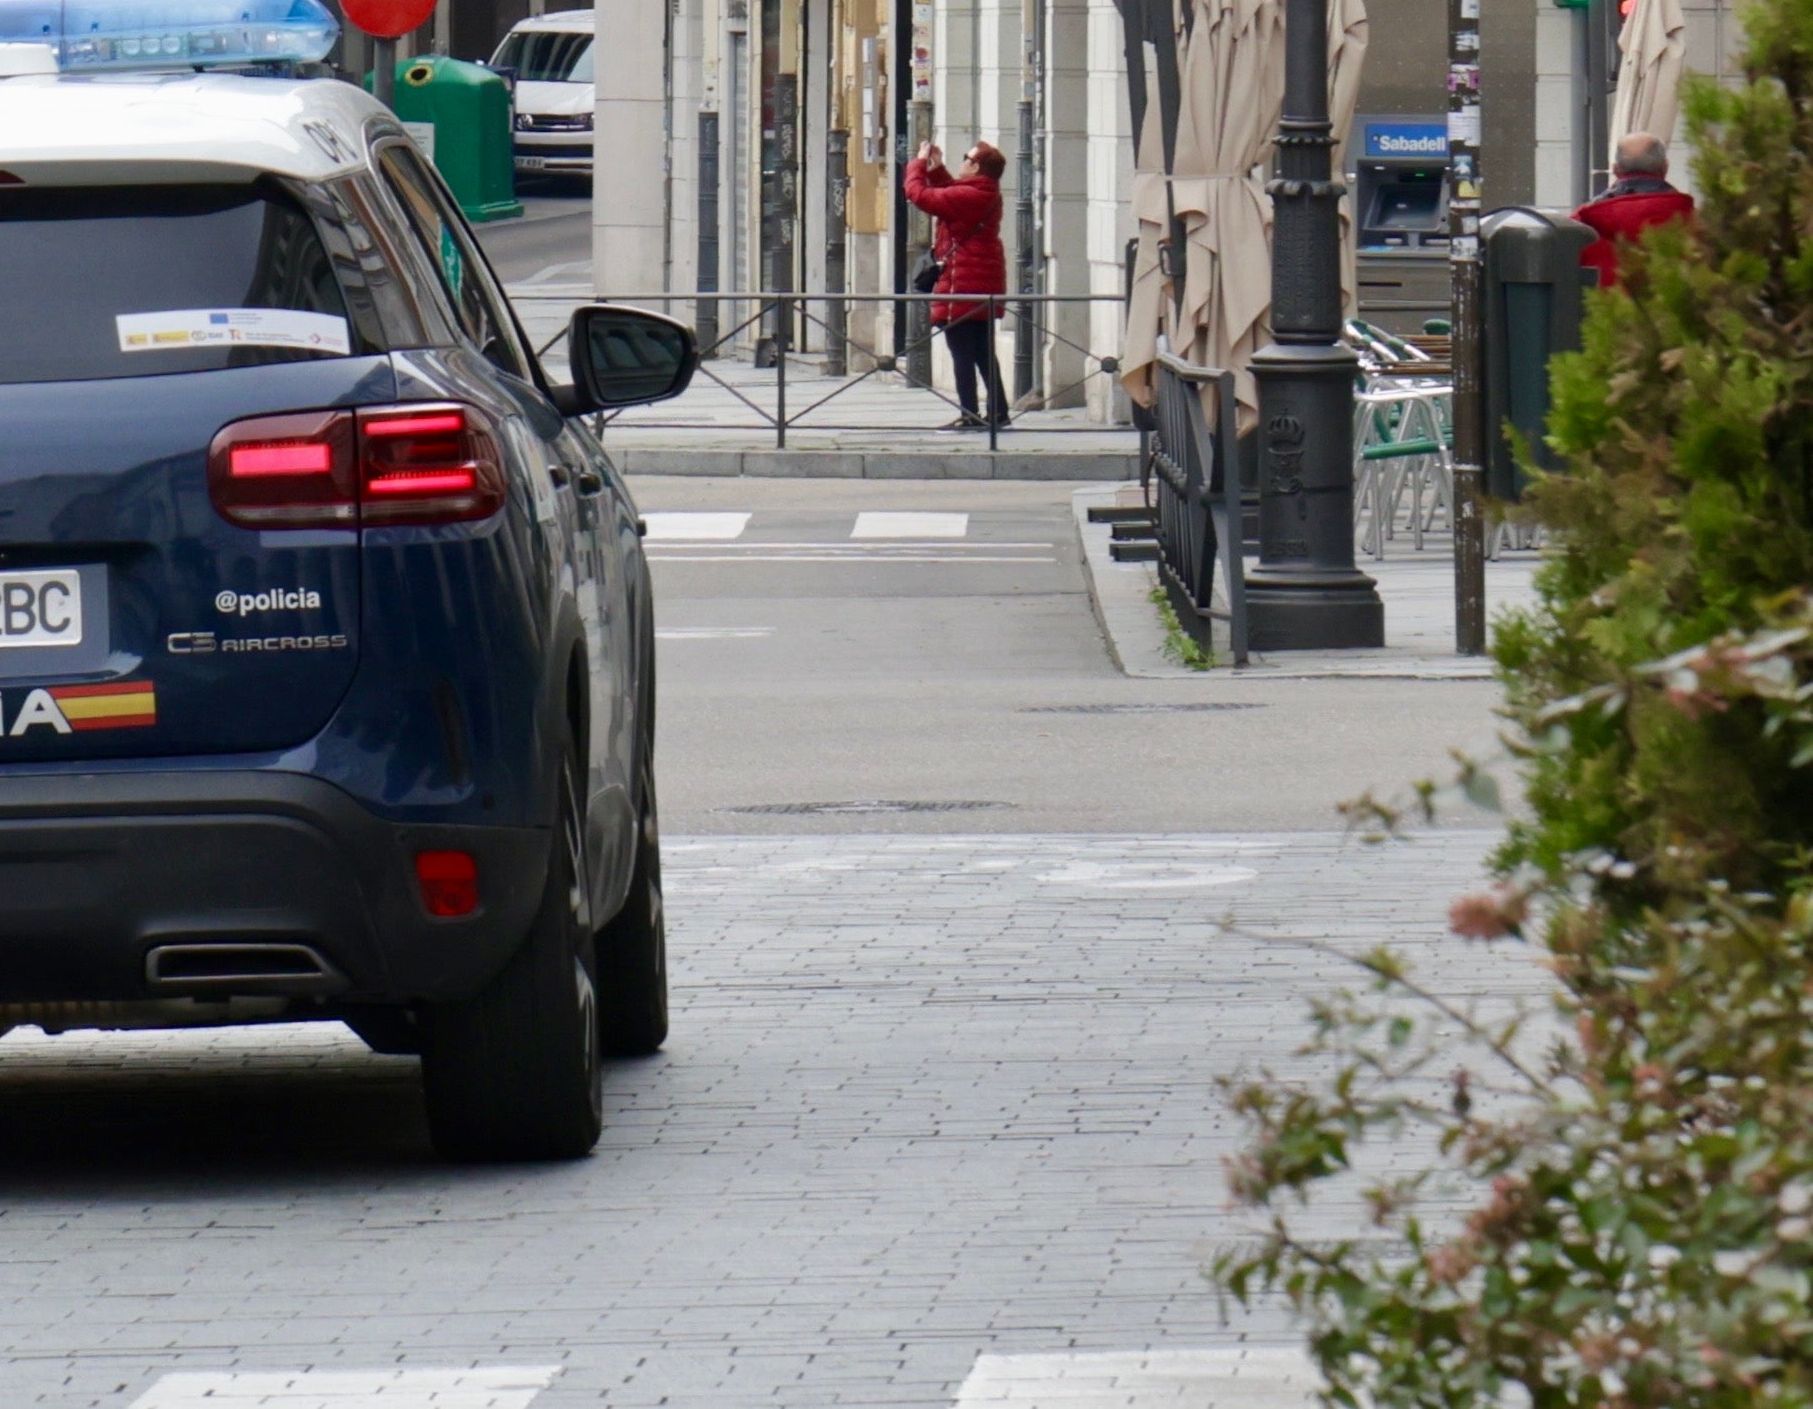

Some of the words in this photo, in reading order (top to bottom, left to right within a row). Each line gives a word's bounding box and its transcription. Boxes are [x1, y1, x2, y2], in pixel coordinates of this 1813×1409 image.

[1379, 134, 1446, 151] Sabadell
[215, 587, 321, 617] @policia
[221, 634, 348, 652] AIRCROSS
